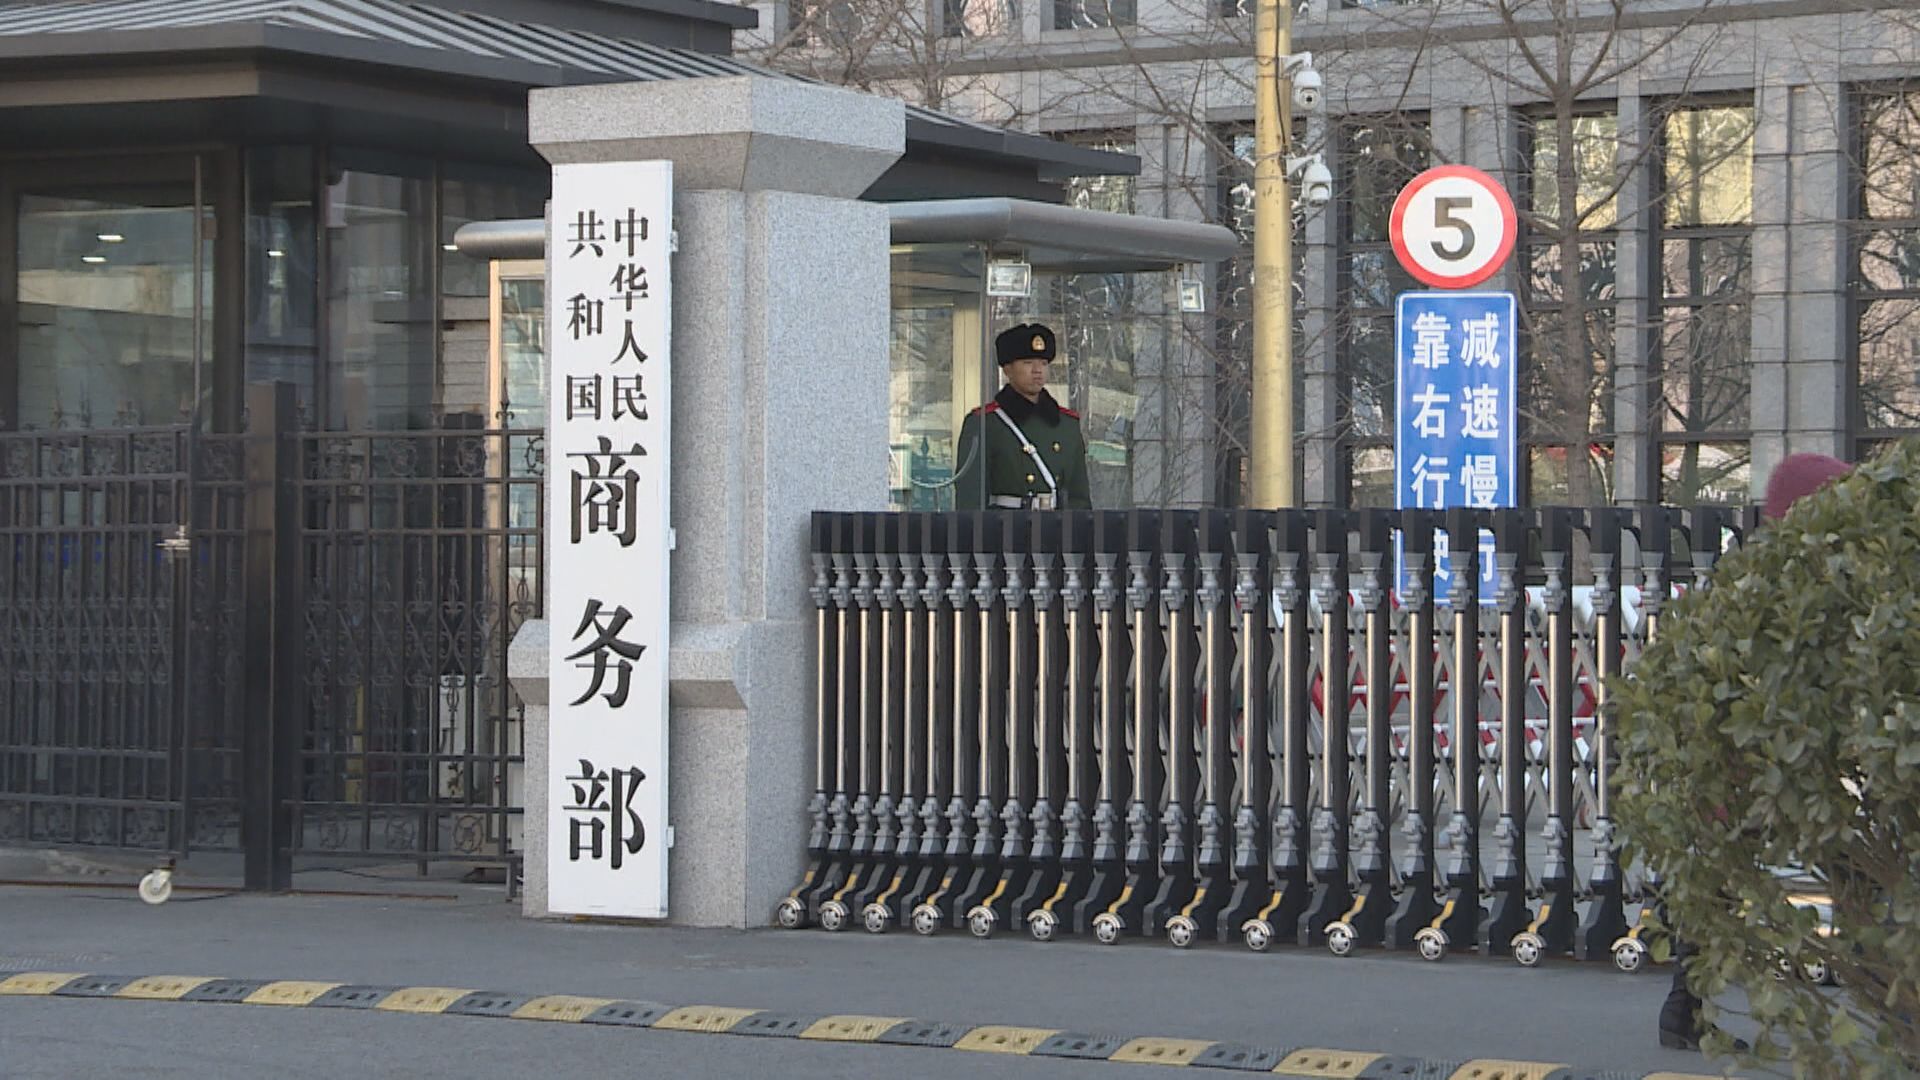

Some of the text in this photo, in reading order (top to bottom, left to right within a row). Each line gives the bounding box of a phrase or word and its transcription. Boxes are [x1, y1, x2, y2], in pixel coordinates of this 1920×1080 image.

[566, 210, 606, 422] 共和国
[609, 208, 649, 421] 中华人民
[1430, 197, 1476, 262] 5
[564, 436, 648, 870] 商务部
